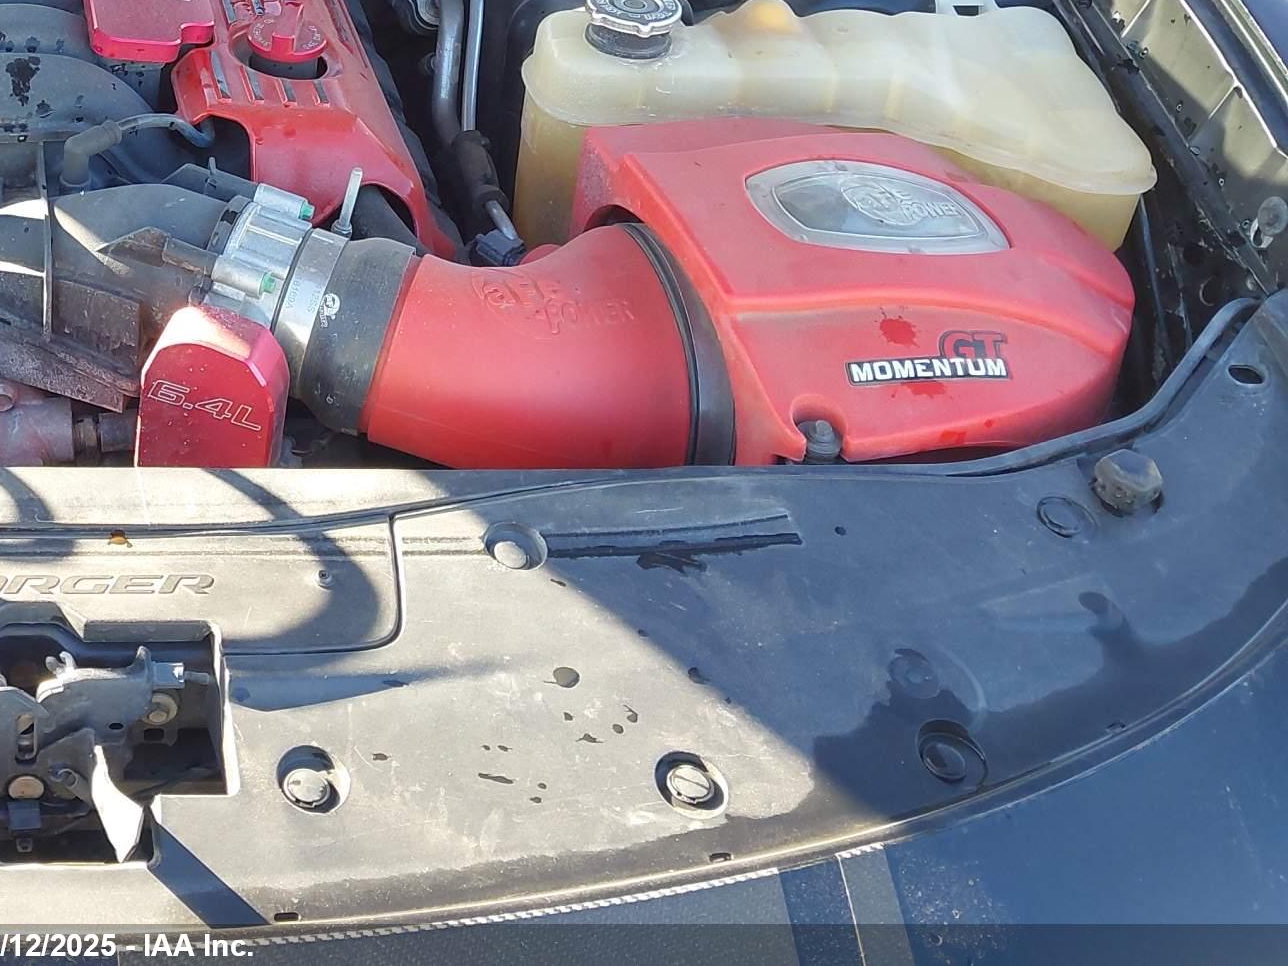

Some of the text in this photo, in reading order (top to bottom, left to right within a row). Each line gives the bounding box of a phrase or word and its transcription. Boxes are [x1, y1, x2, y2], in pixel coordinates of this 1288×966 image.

[899, 201, 962, 221] POWER
[938, 330, 1008, 360] GT
[849, 357, 1008, 383] MOMENTUM
[147, 379, 262, 432] 6.4L
